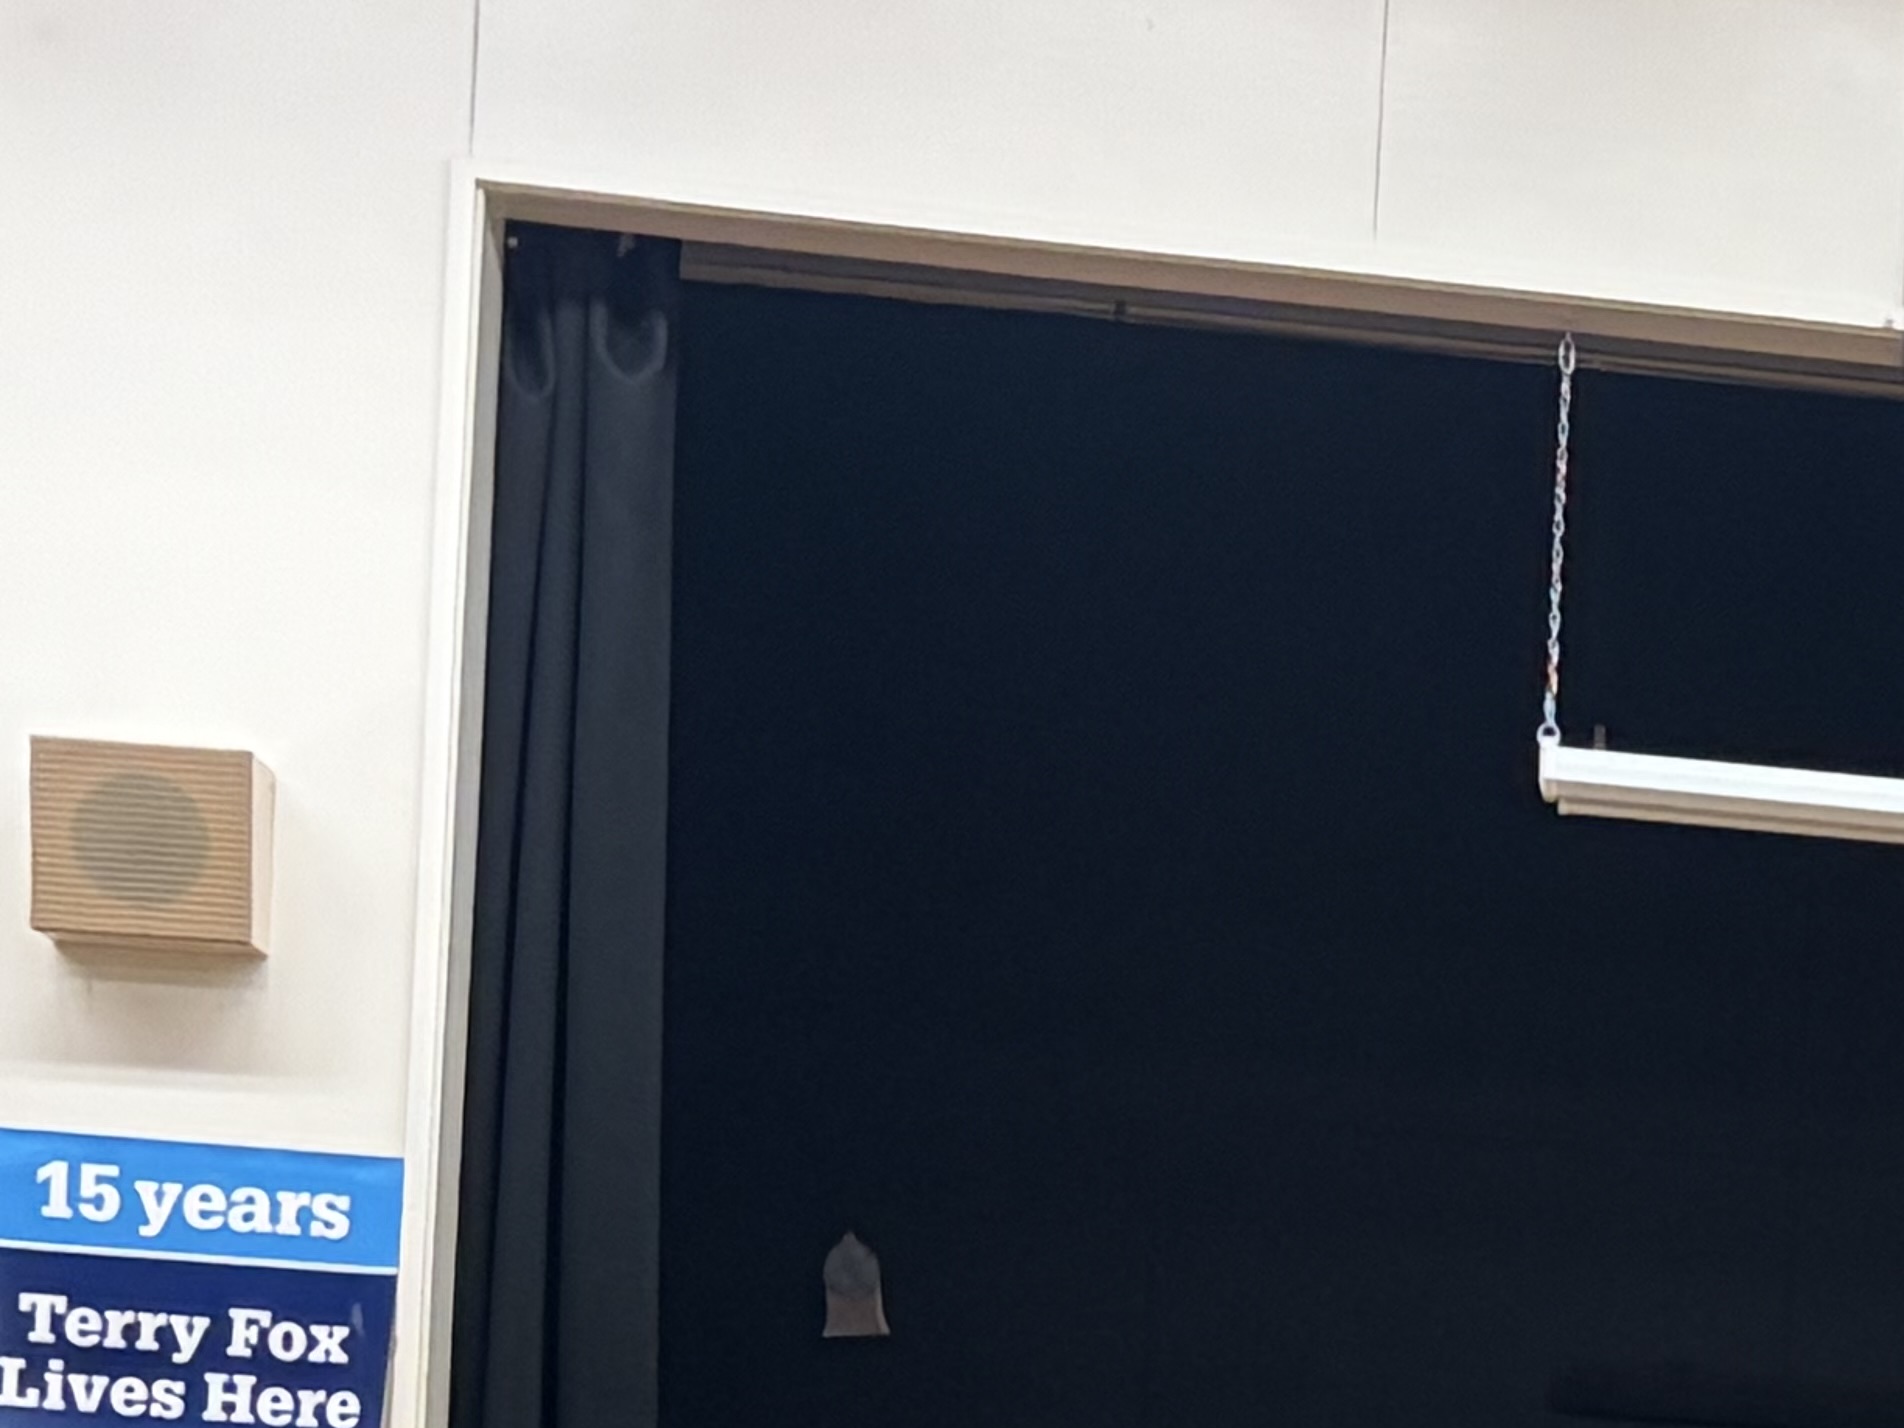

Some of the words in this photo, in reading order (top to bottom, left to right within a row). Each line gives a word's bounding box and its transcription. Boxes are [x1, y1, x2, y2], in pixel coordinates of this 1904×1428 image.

[36, 1160, 121, 1222] 15
[134, 1180, 351, 1240] years
[18, 1292, 211, 1364] Terry
[226, 1307, 350, 1364] Fox
[0, 1356, 186, 1419] Lives
